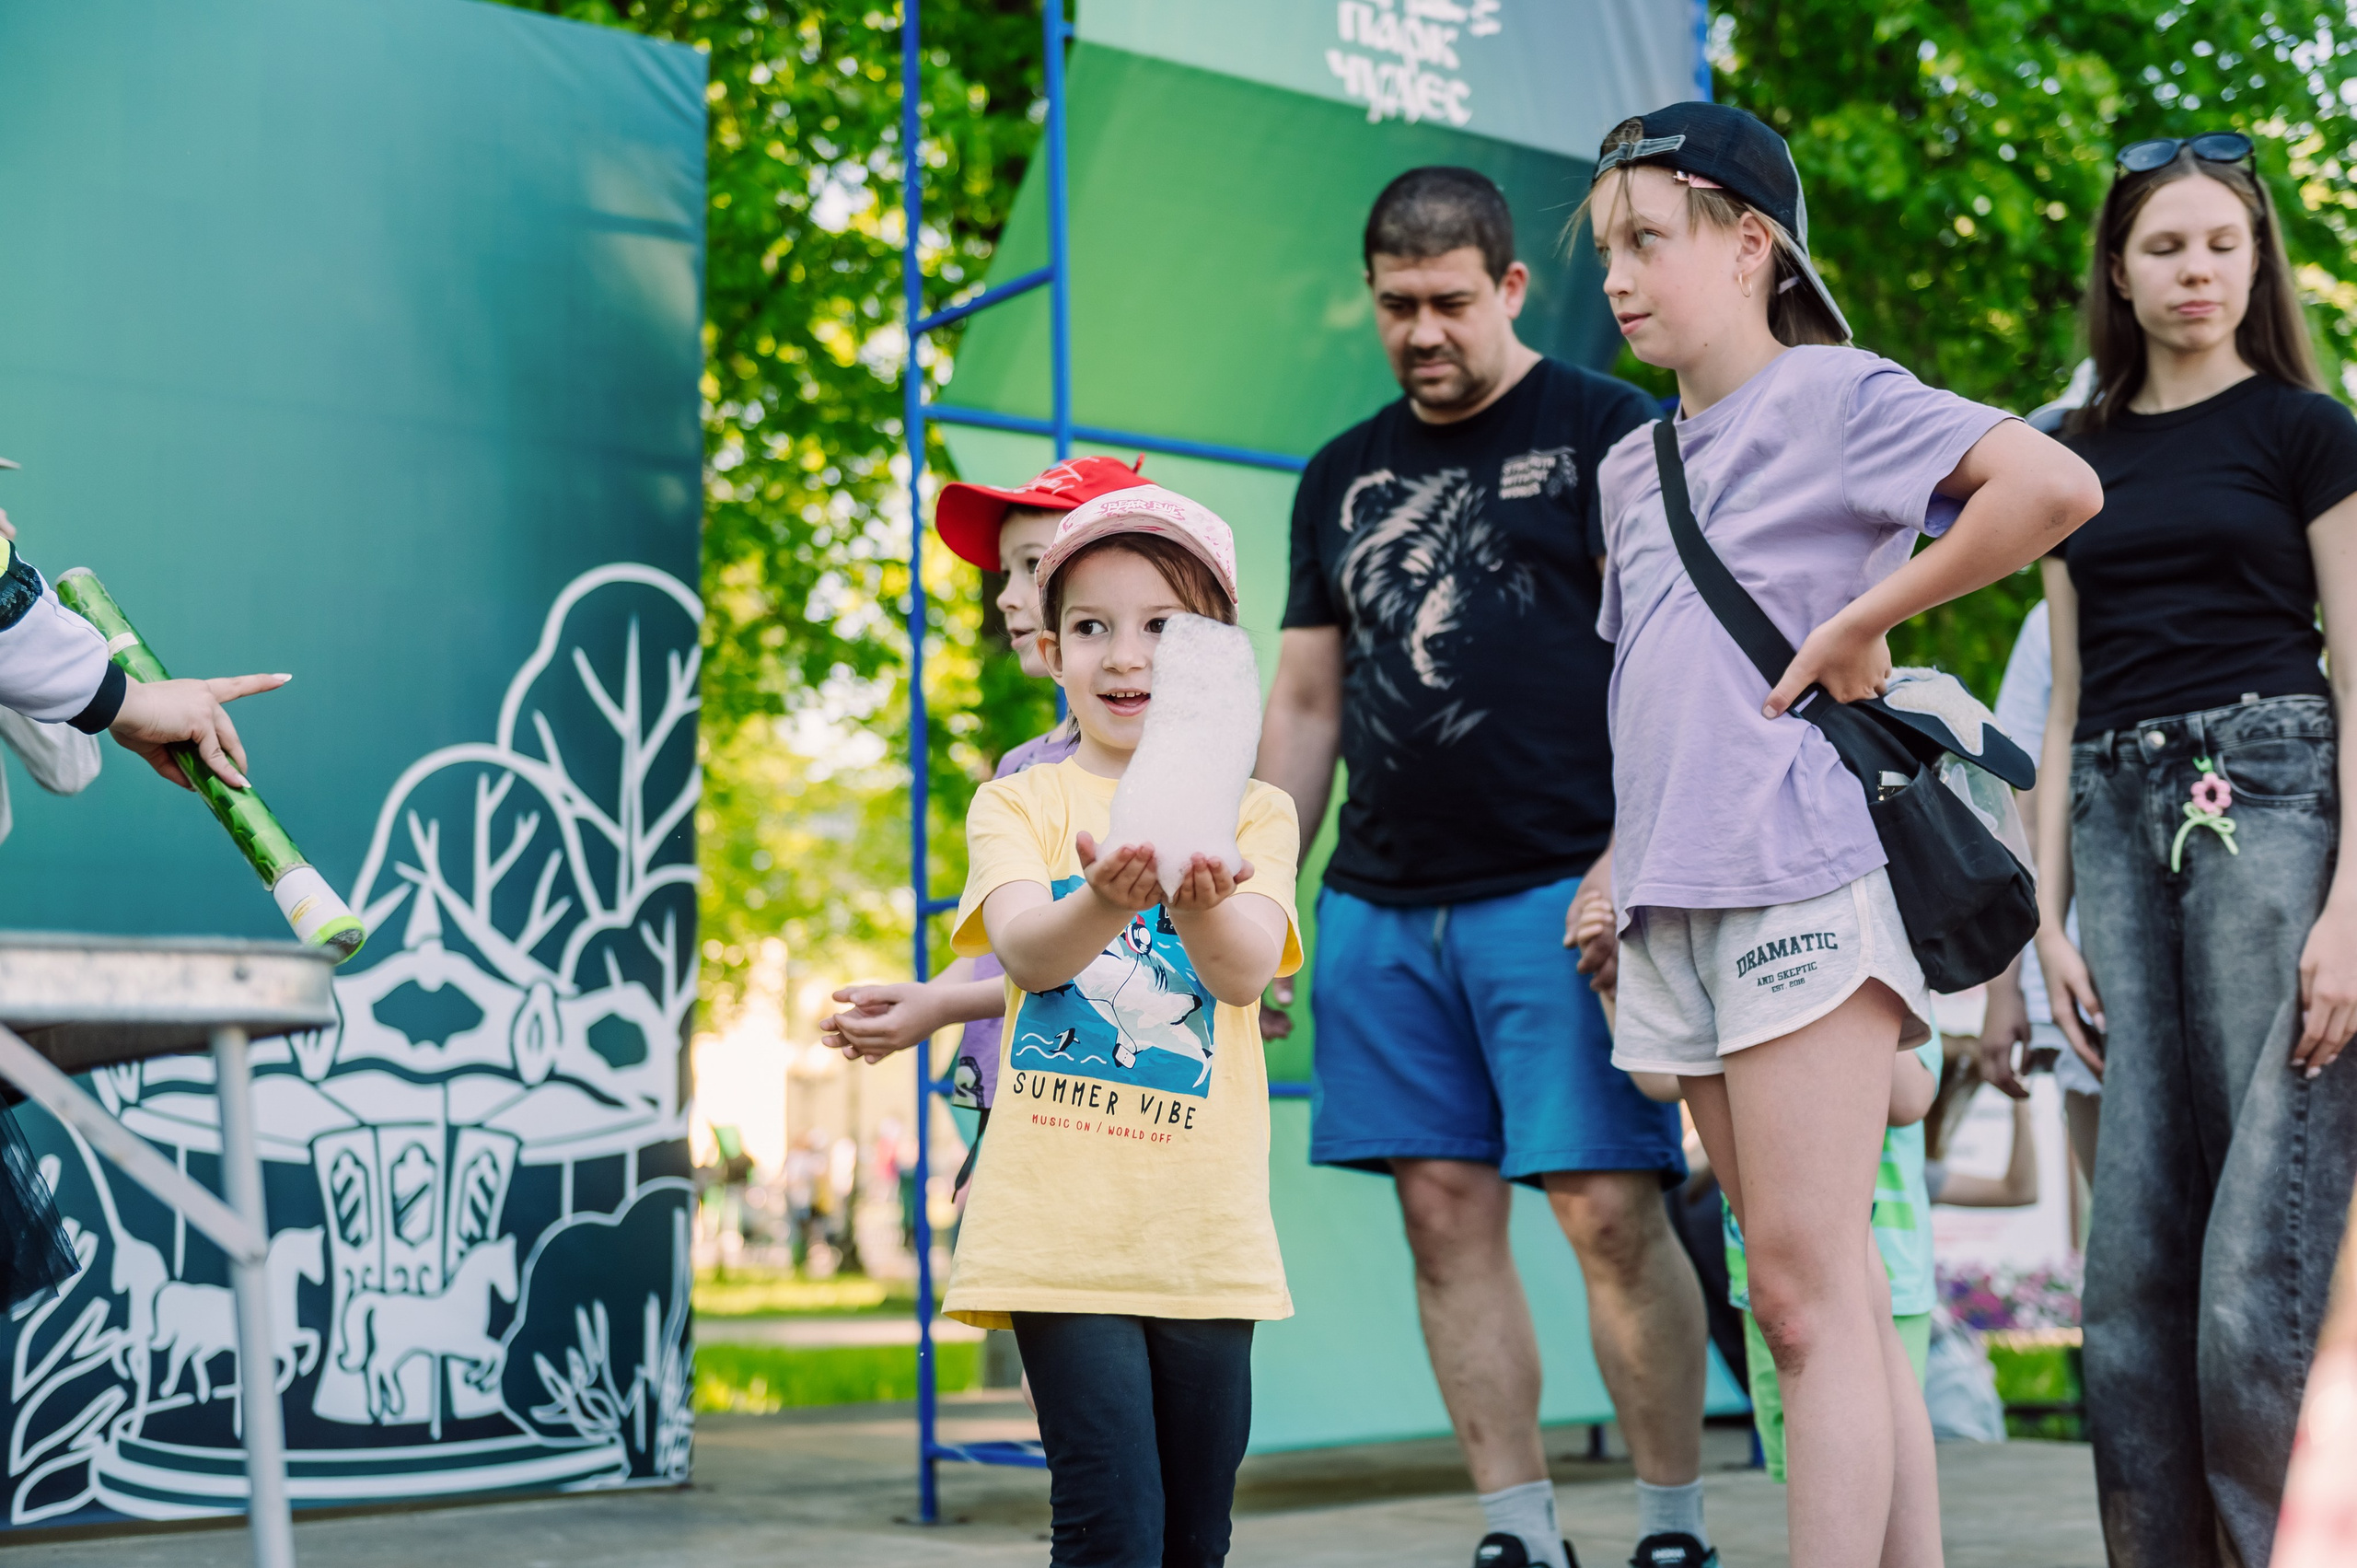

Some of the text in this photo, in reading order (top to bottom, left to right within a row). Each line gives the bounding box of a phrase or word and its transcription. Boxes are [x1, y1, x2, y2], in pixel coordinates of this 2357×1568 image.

[1736, 932, 1838, 978] DRAMATIC
[1757, 961, 1817, 987] AND SKEPTIC
[1013, 1072, 1196, 1130] SUMMER VIBE
[1032, 1114, 1070, 1129] MUSIC
[1076, 1121, 1091, 1132] ON
[1108, 1125, 1144, 1140] WORLD
[1150, 1132, 1172, 1144] OFF
